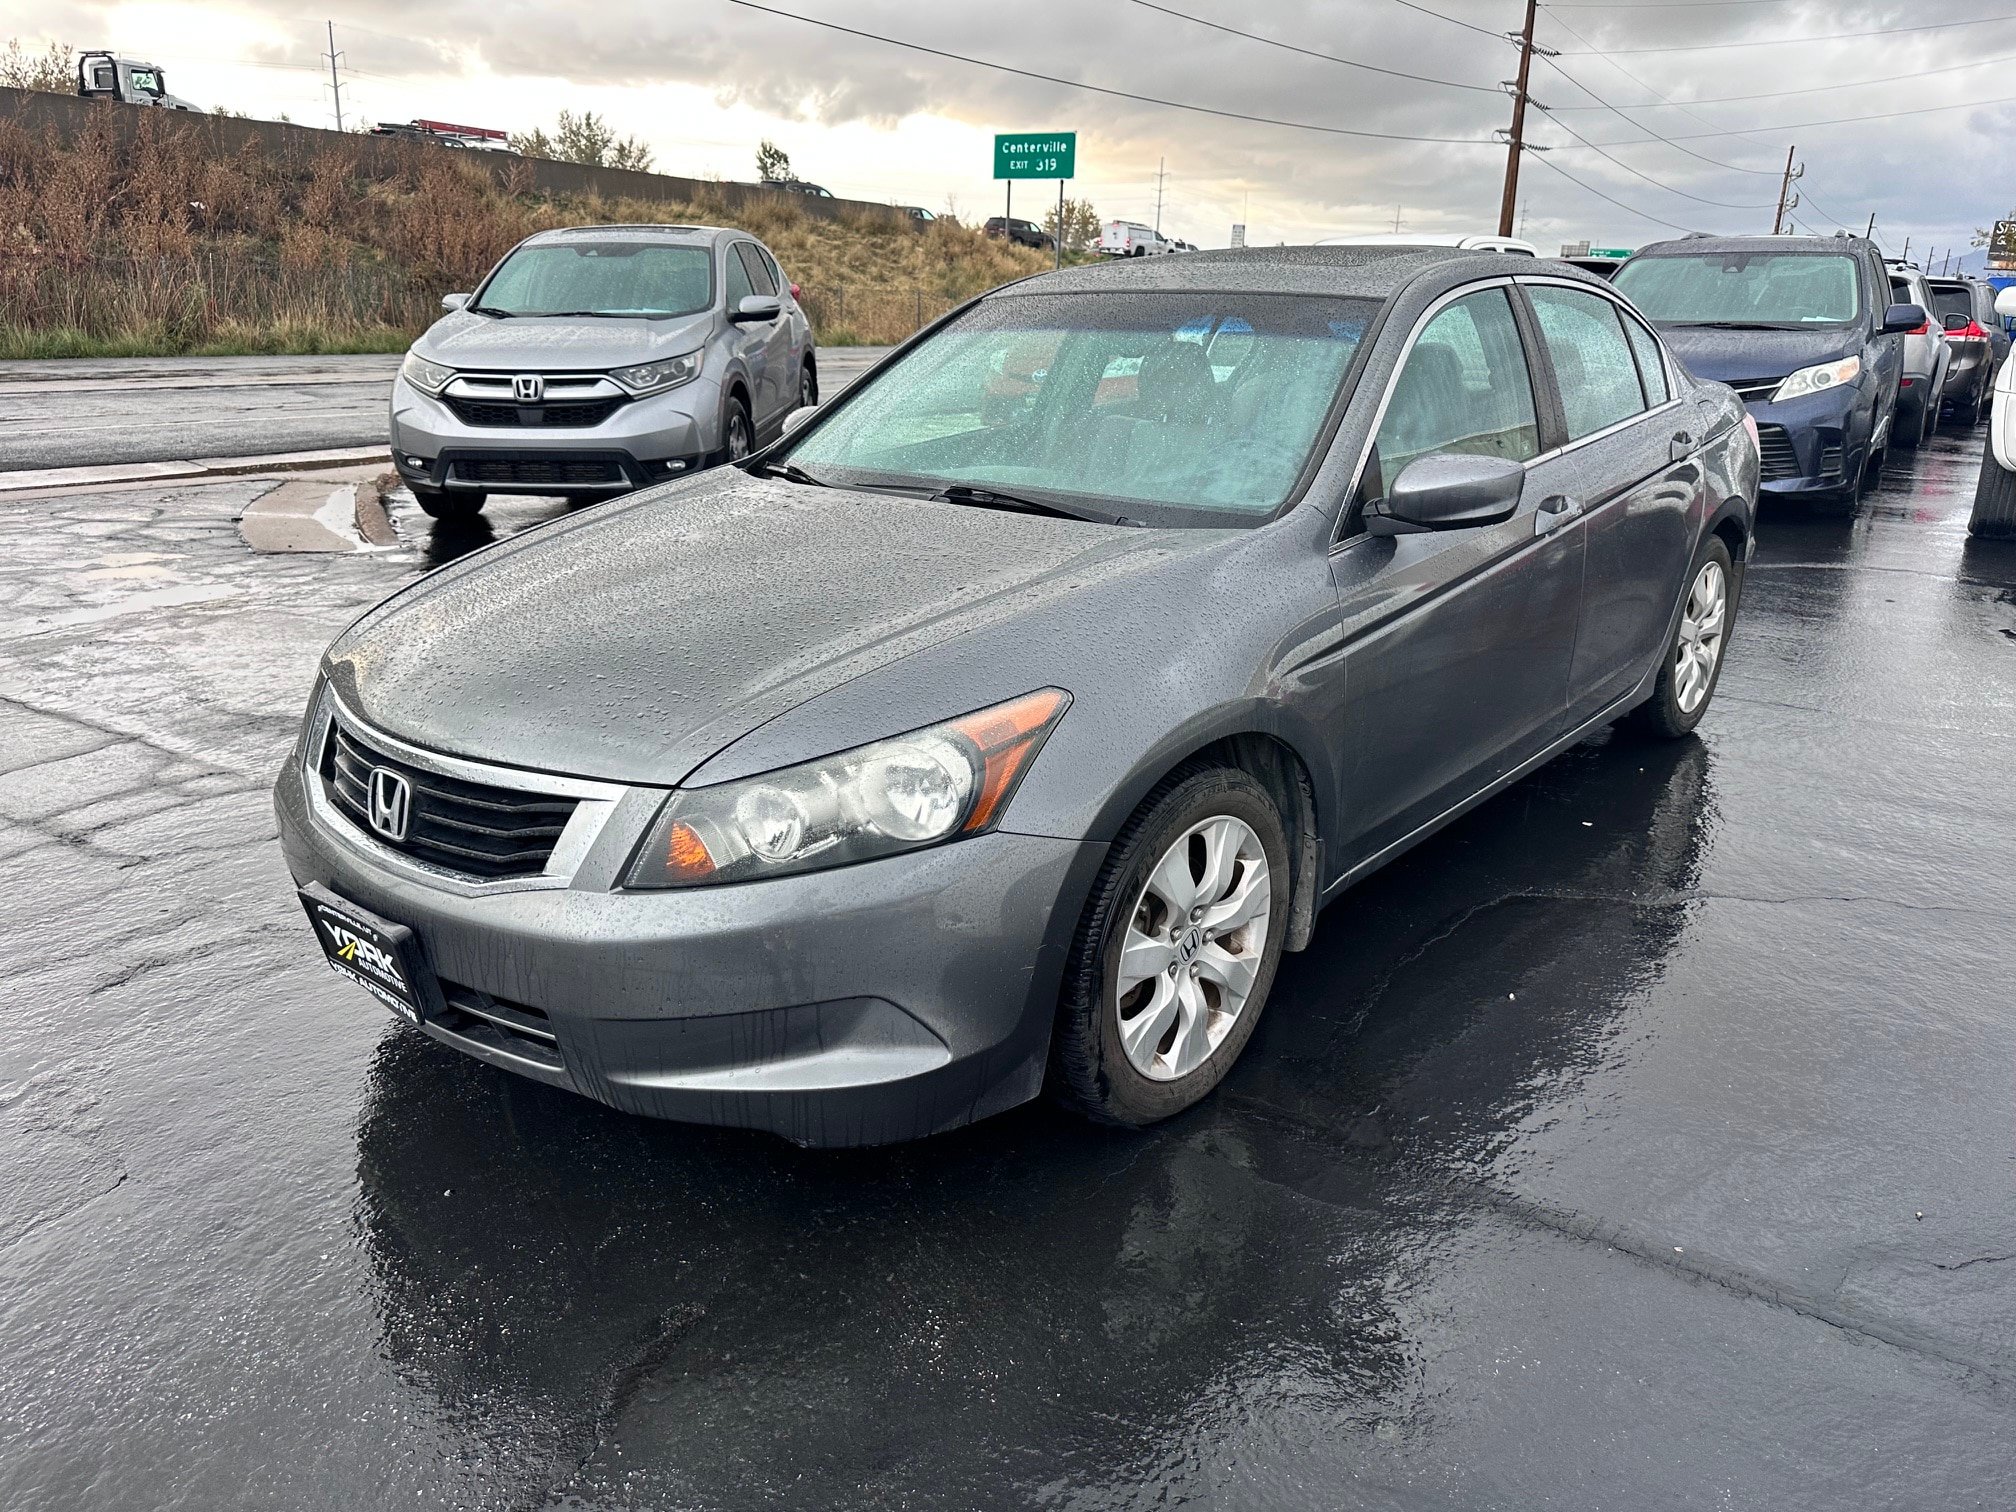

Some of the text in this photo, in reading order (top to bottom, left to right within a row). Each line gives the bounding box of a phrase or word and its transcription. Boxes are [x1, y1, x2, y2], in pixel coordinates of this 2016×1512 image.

[1002, 141, 1067, 153] Centerville
[1009, 158, 1057, 171] EXIT 319
[321, 919, 403, 981] YORK
[358, 957, 408, 993] AUTOMOTIVE
[359, 976, 418, 1023] AUTOMOTIVE
